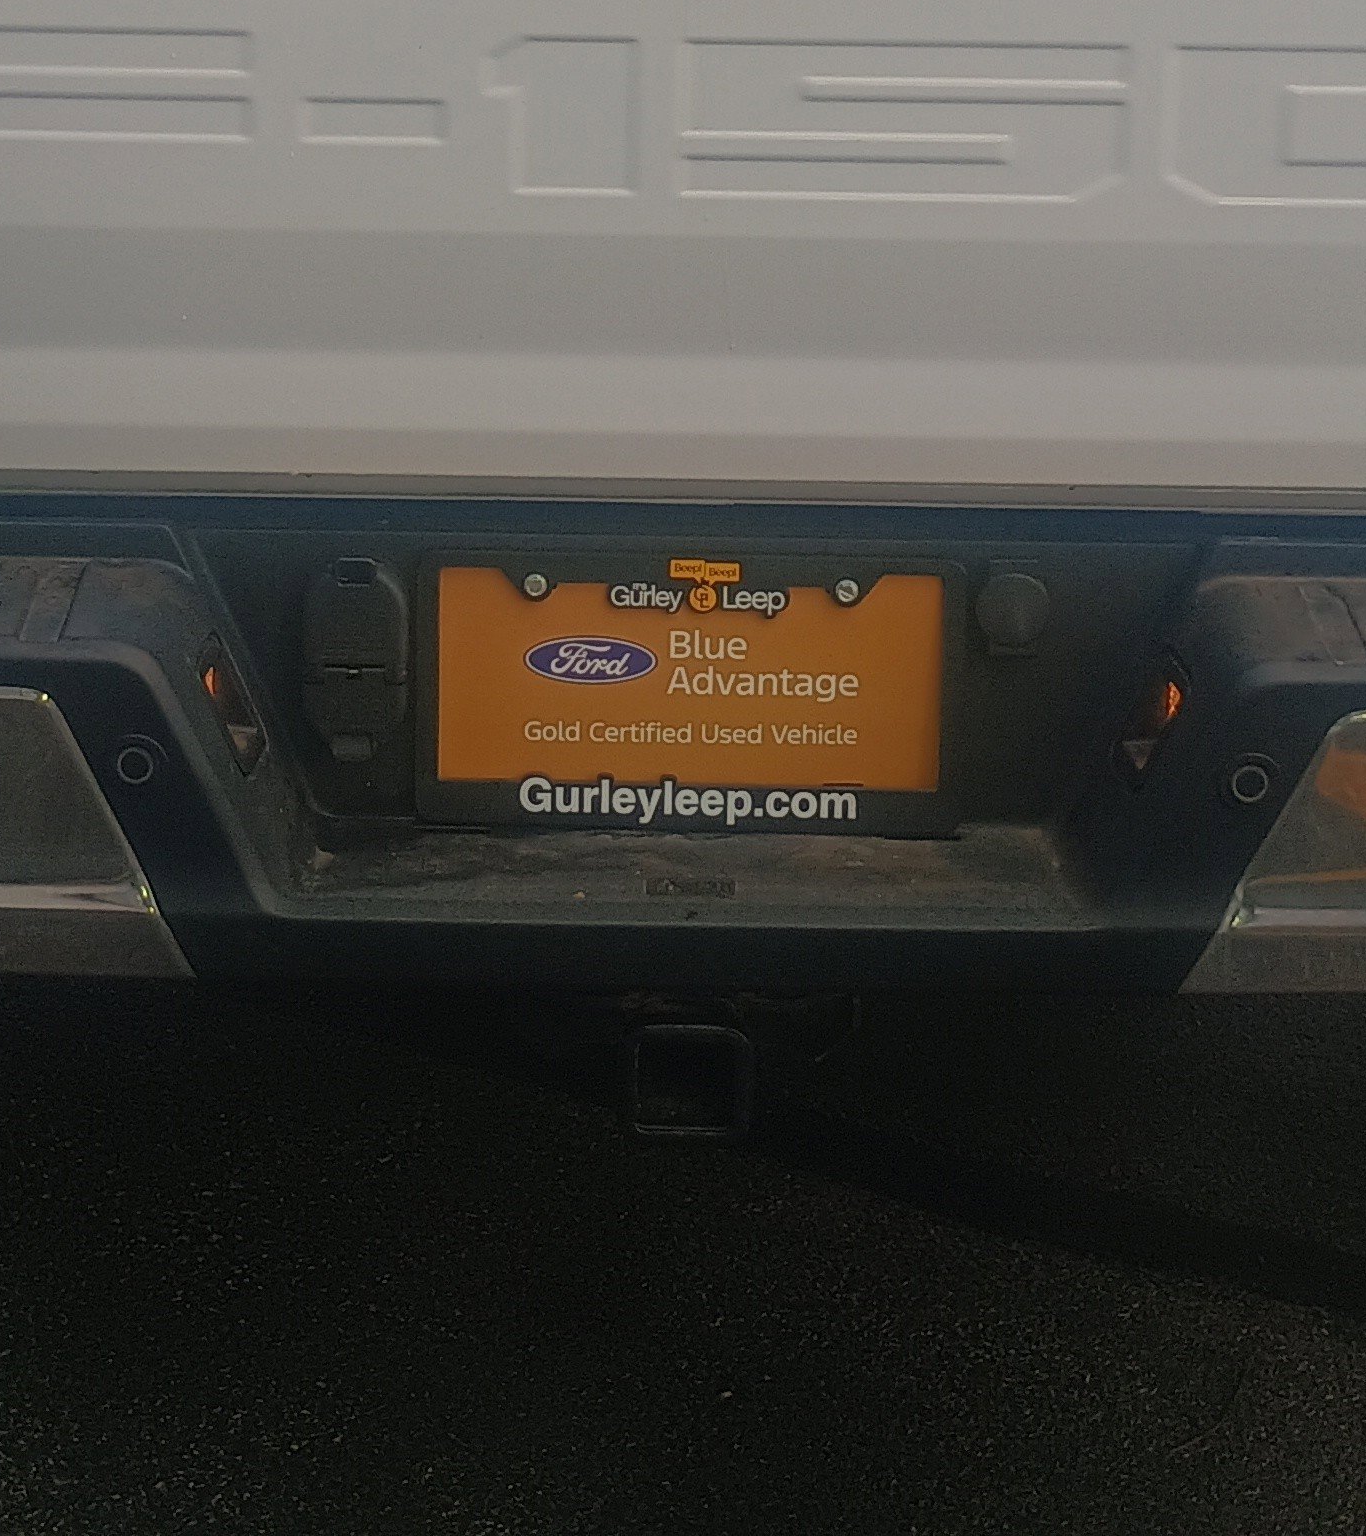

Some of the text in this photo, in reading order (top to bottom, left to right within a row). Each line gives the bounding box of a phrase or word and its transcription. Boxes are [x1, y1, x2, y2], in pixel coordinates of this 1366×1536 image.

[722, 585, 785, 616] Leep
[550, 642, 630, 677] Ford
[669, 629, 748, 661] Blue
[666, 665, 859, 704] Advantage
[524, 720, 858, 746] Gold Certified Used Vehicle
[519, 776, 858, 826] Gurleyleep.com
